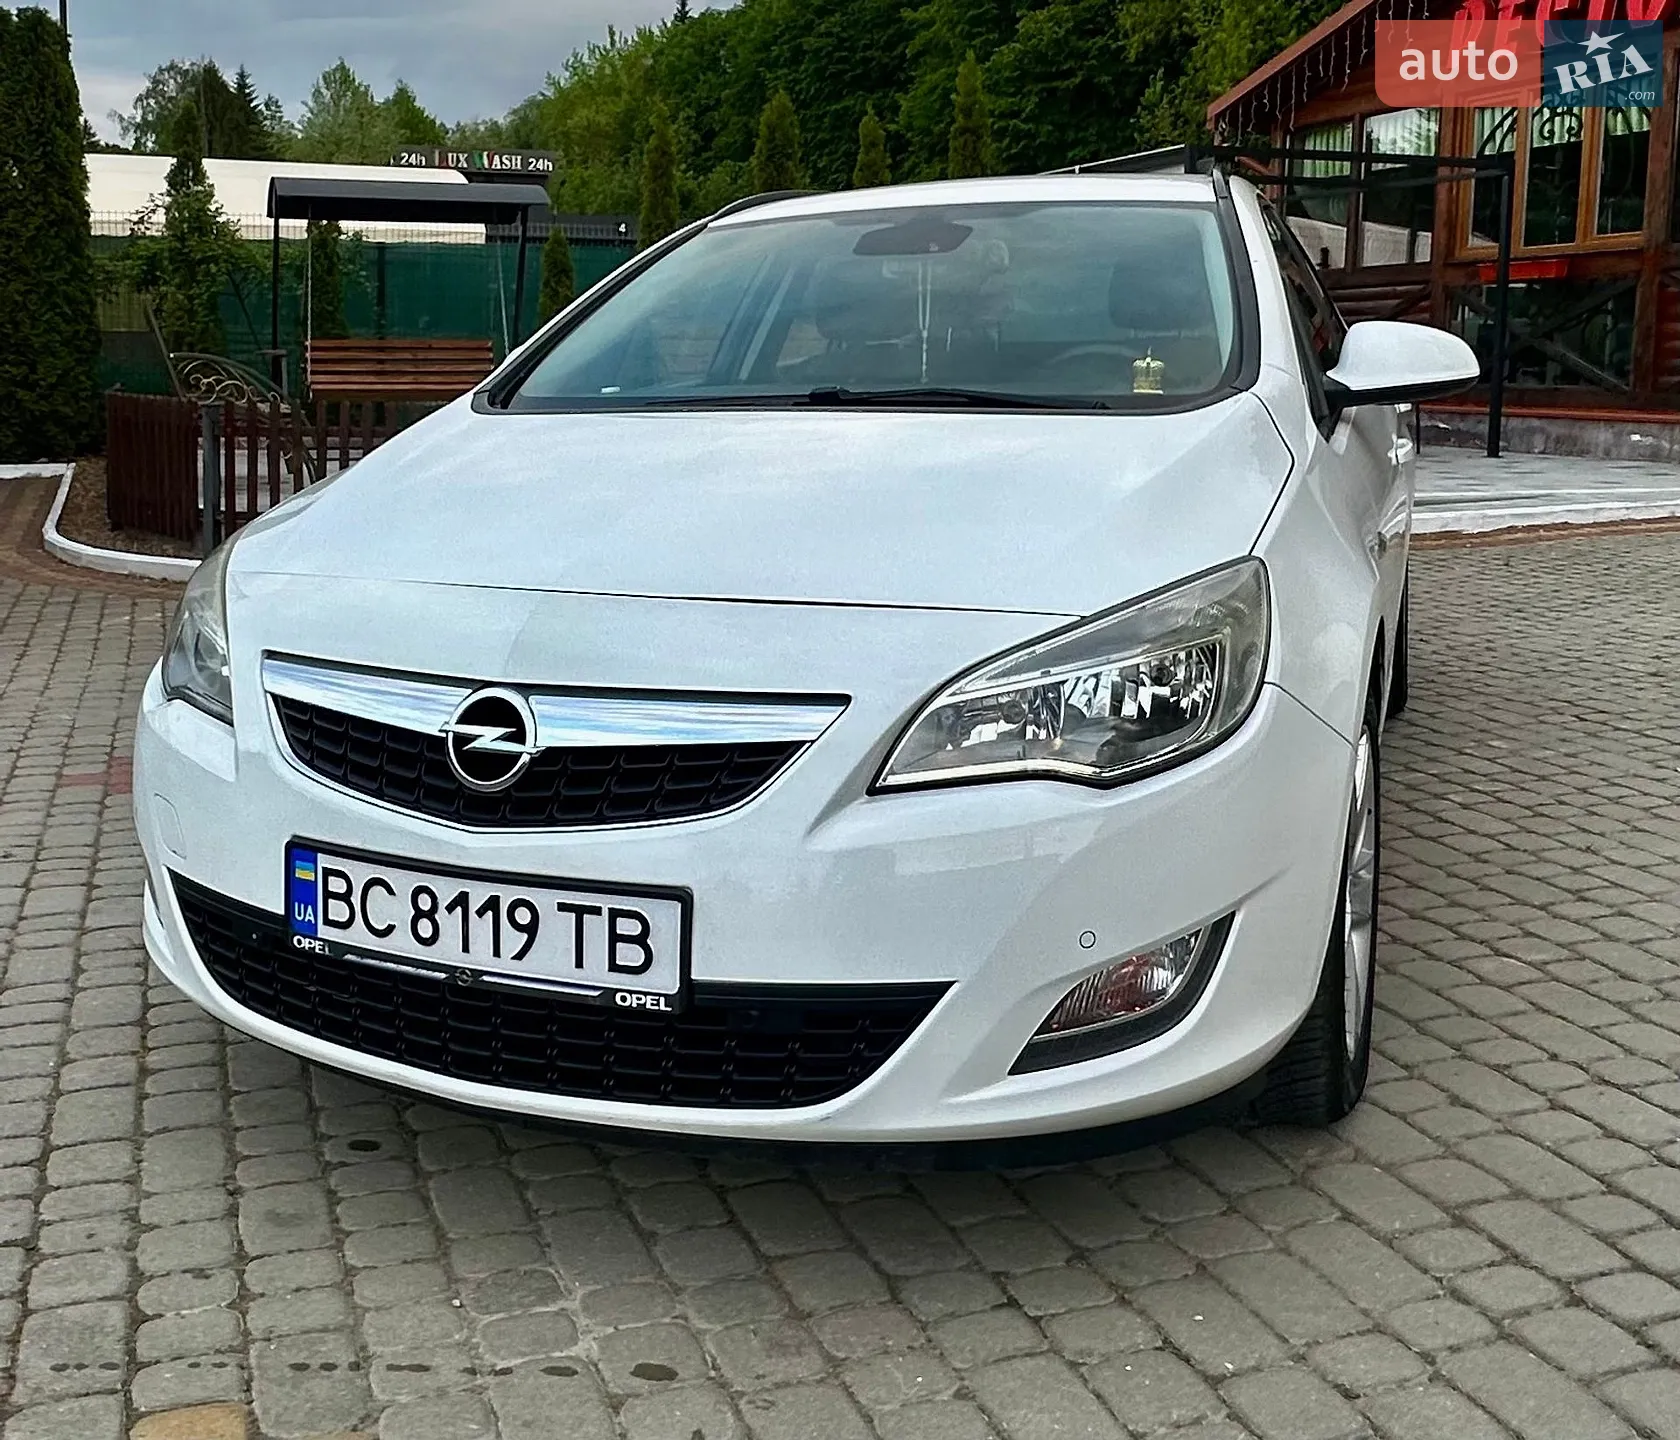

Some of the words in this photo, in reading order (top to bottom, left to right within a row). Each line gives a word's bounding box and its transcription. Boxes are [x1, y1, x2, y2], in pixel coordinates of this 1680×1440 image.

[400, 152, 426, 166] 24h
[434, 149, 468, 169] LUX
[472, 150, 522, 170] WASH
[527, 158, 554, 171] 24h
[294, 901, 316, 924] UA
[321, 866, 397, 939] BC
[409, 884, 540, 961] 8119
[556, 901, 654, 976] TB
[292, 935, 332, 955] OPEL
[615, 991, 673, 1011] OPEL
